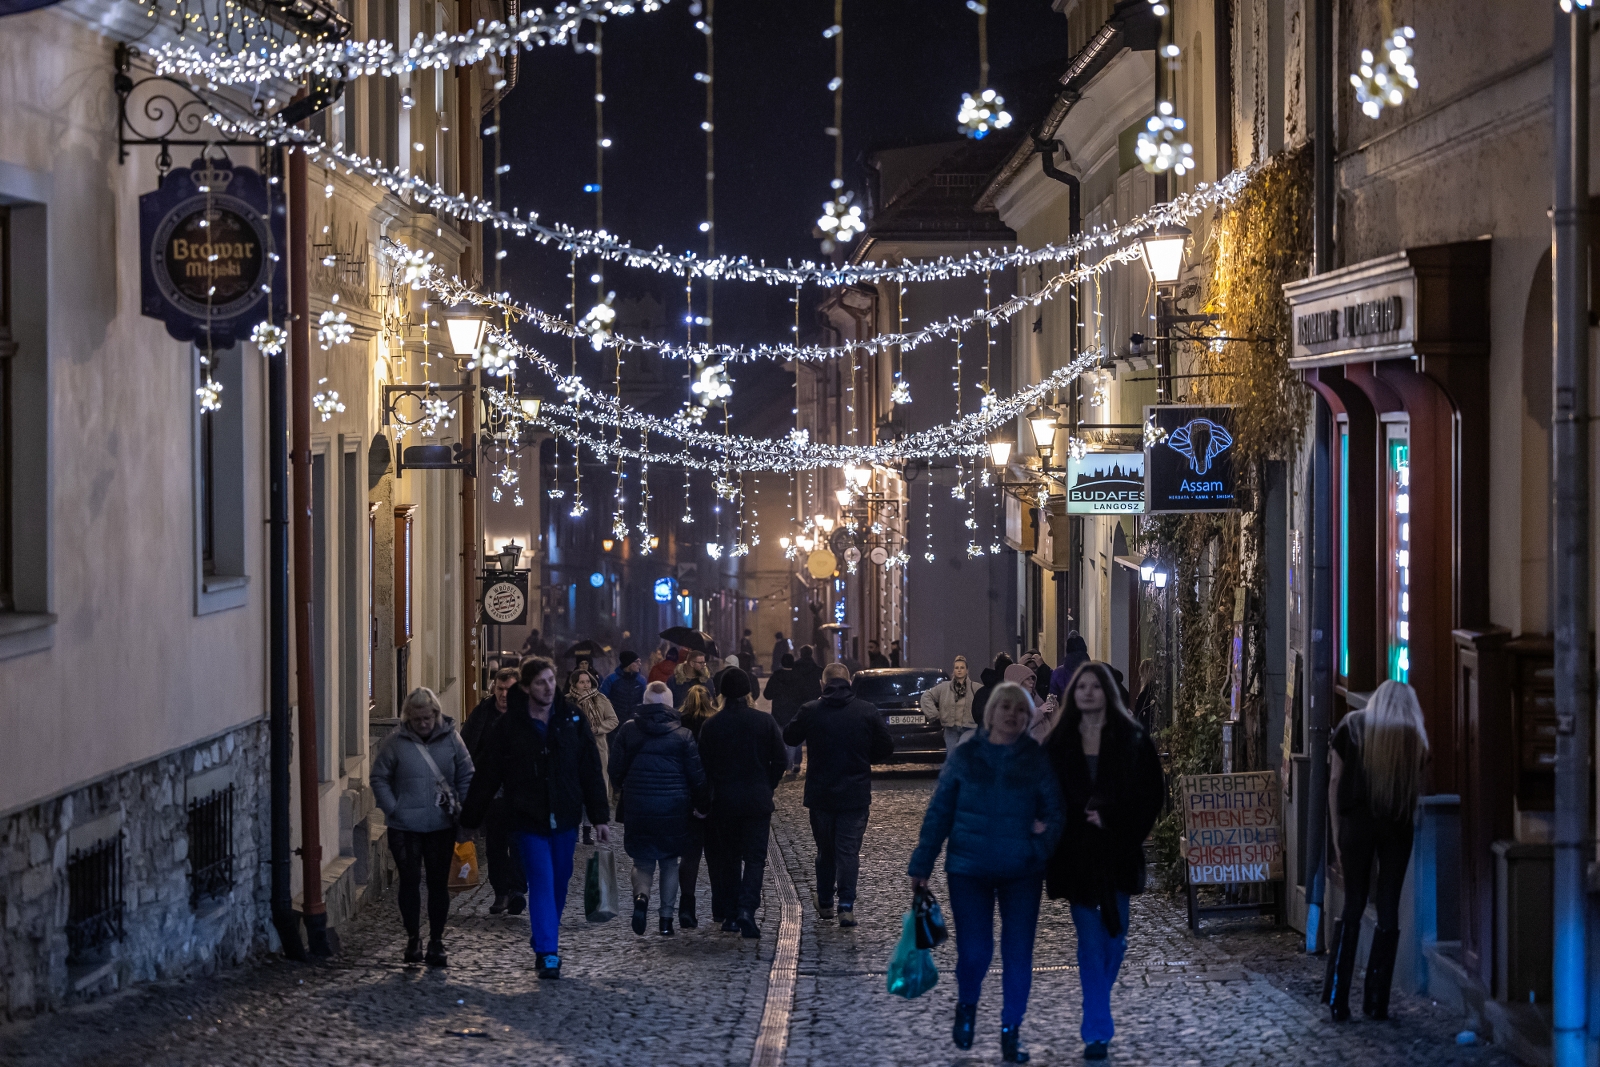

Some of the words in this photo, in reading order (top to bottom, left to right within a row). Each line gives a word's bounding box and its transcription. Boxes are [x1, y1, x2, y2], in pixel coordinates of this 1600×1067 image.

[173, 239, 254, 259] Browar
[1180, 479, 1223, 492] Assam
[891, 716, 900, 724] SB
[1185, 775, 1271, 792] HERBATY
[1191, 809, 1275, 828] MAGNESY
[1187, 845, 1242, 866] SHISHA
[1245, 844, 1281, 863] SHOP
[1190, 863, 1271, 883] UPOMINKI
